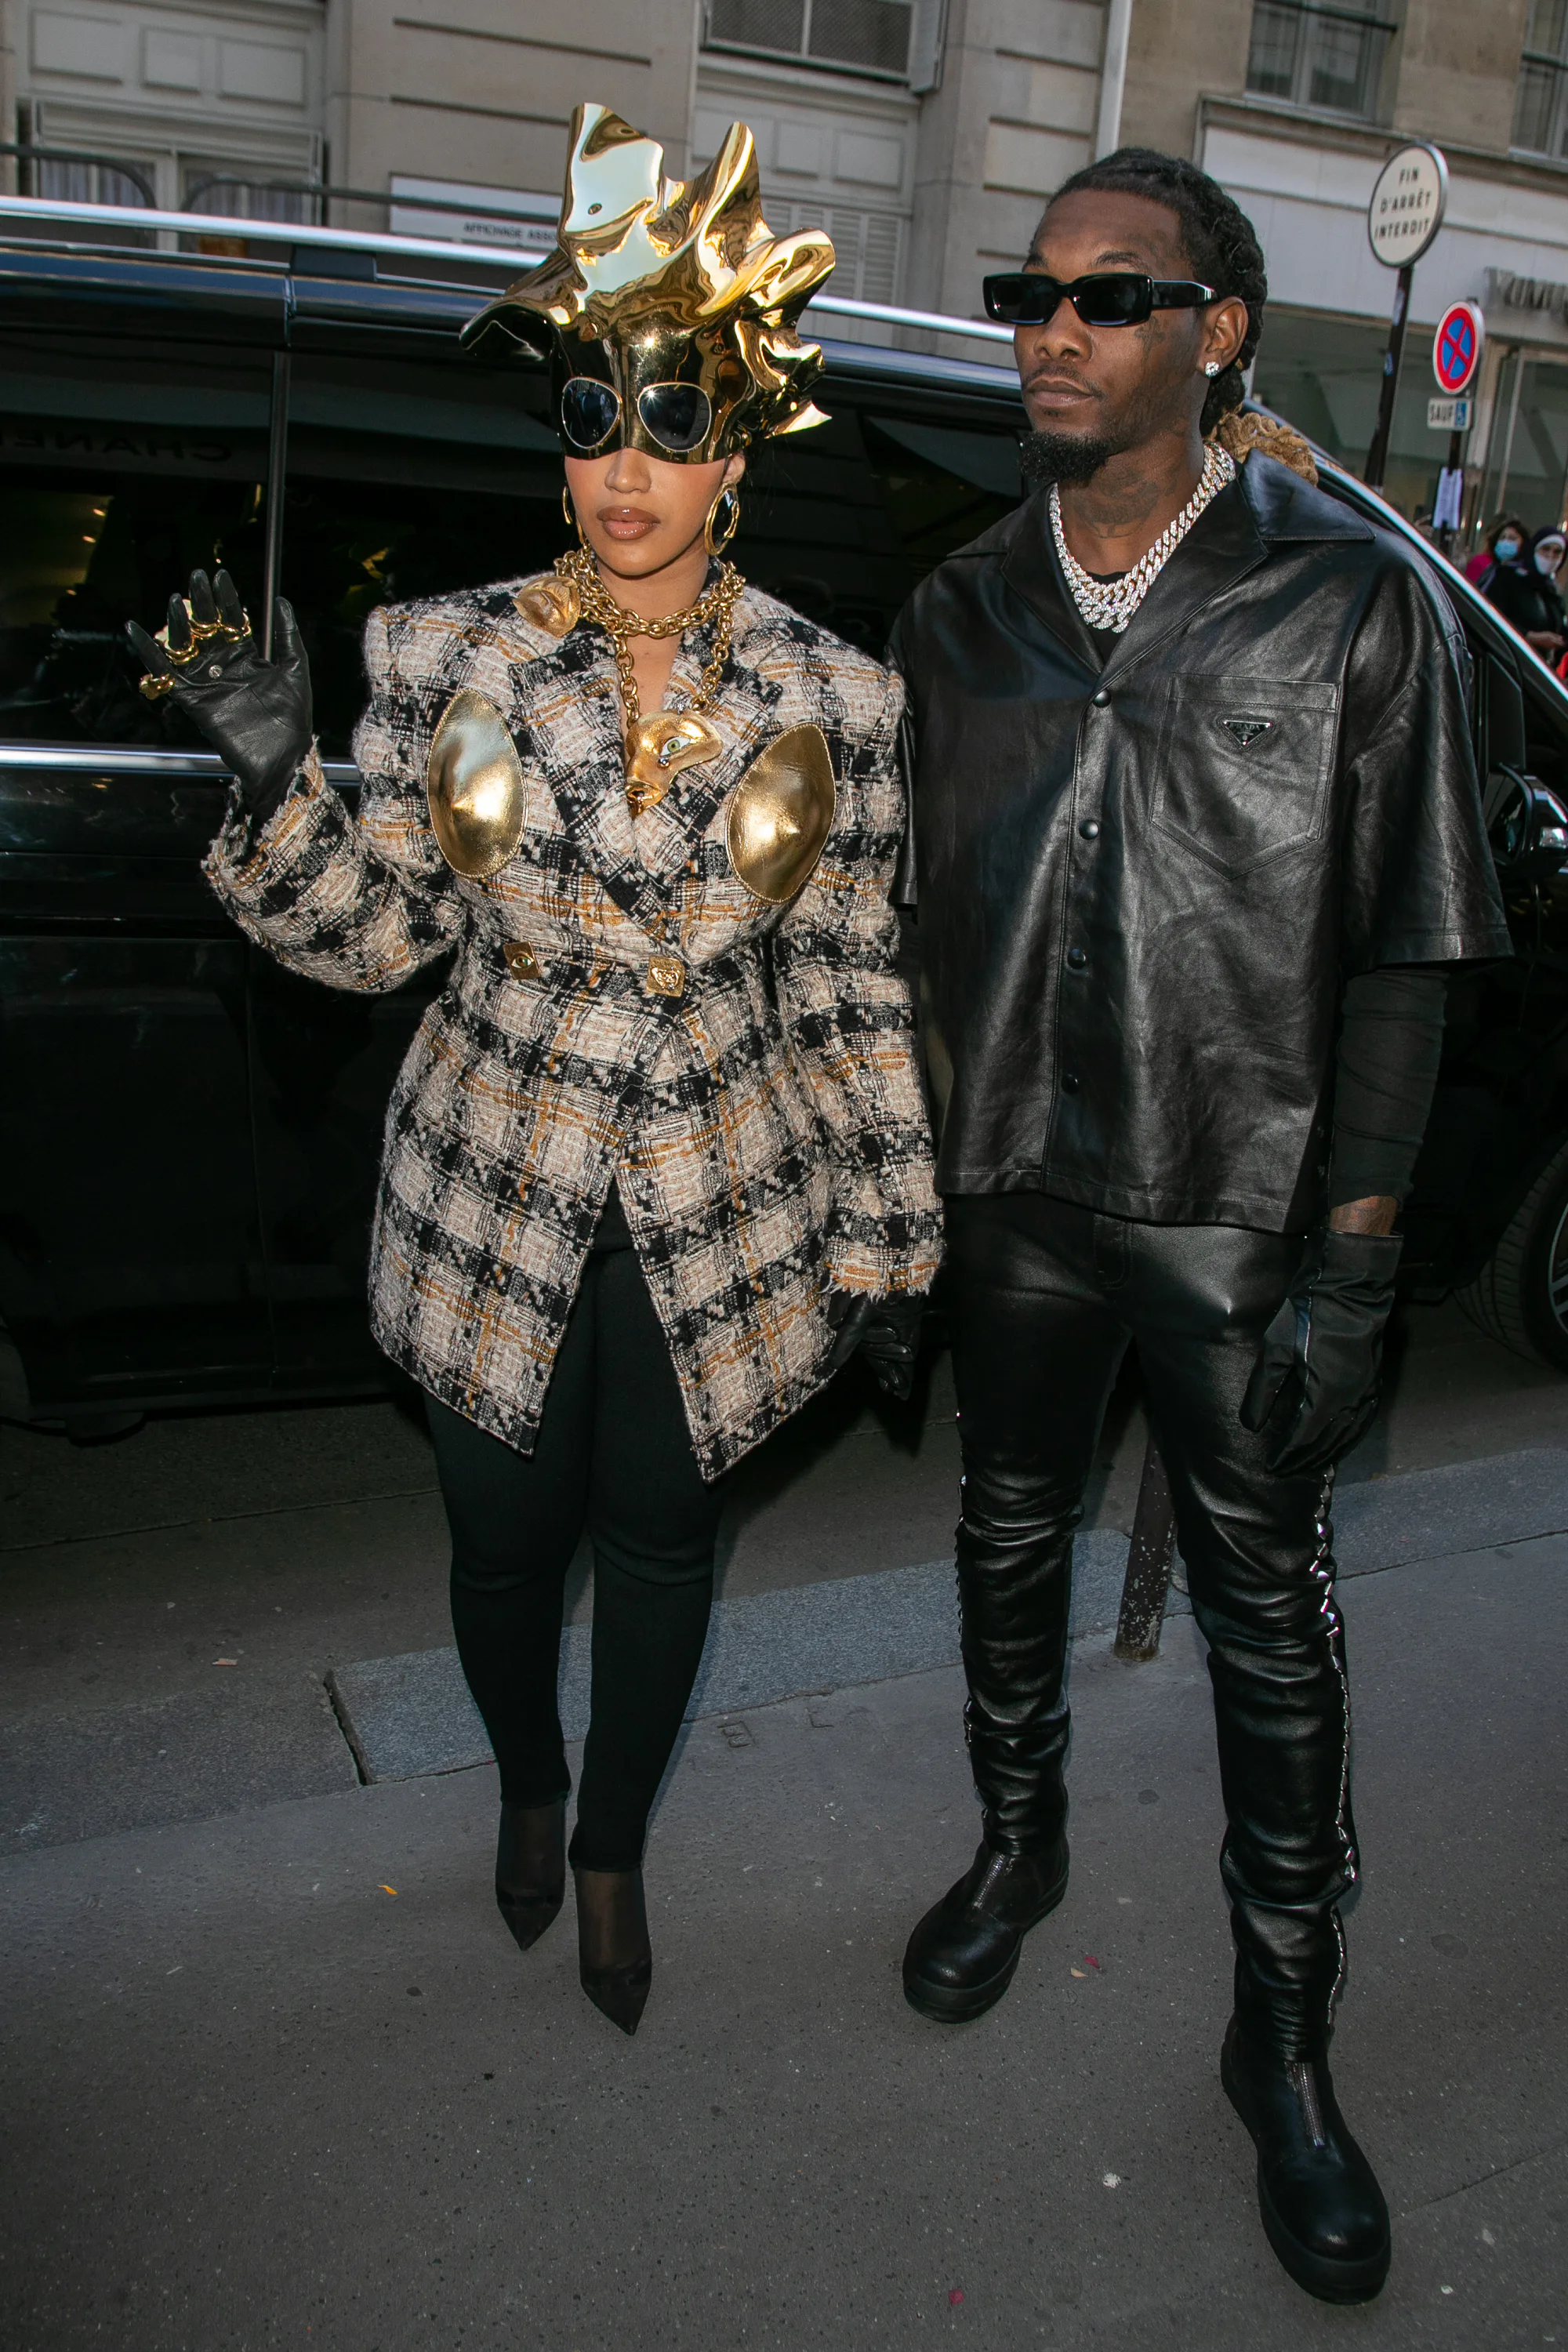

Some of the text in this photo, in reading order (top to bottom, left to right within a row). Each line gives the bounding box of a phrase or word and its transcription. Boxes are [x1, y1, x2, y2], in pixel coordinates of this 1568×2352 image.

[1399, 167, 1418, 185] FIN
[1380, 188, 1431, 214] D'ARRÊT
[1374, 218, 1429, 239] INTERDIT
[1430, 404, 1453, 422] SAUF
